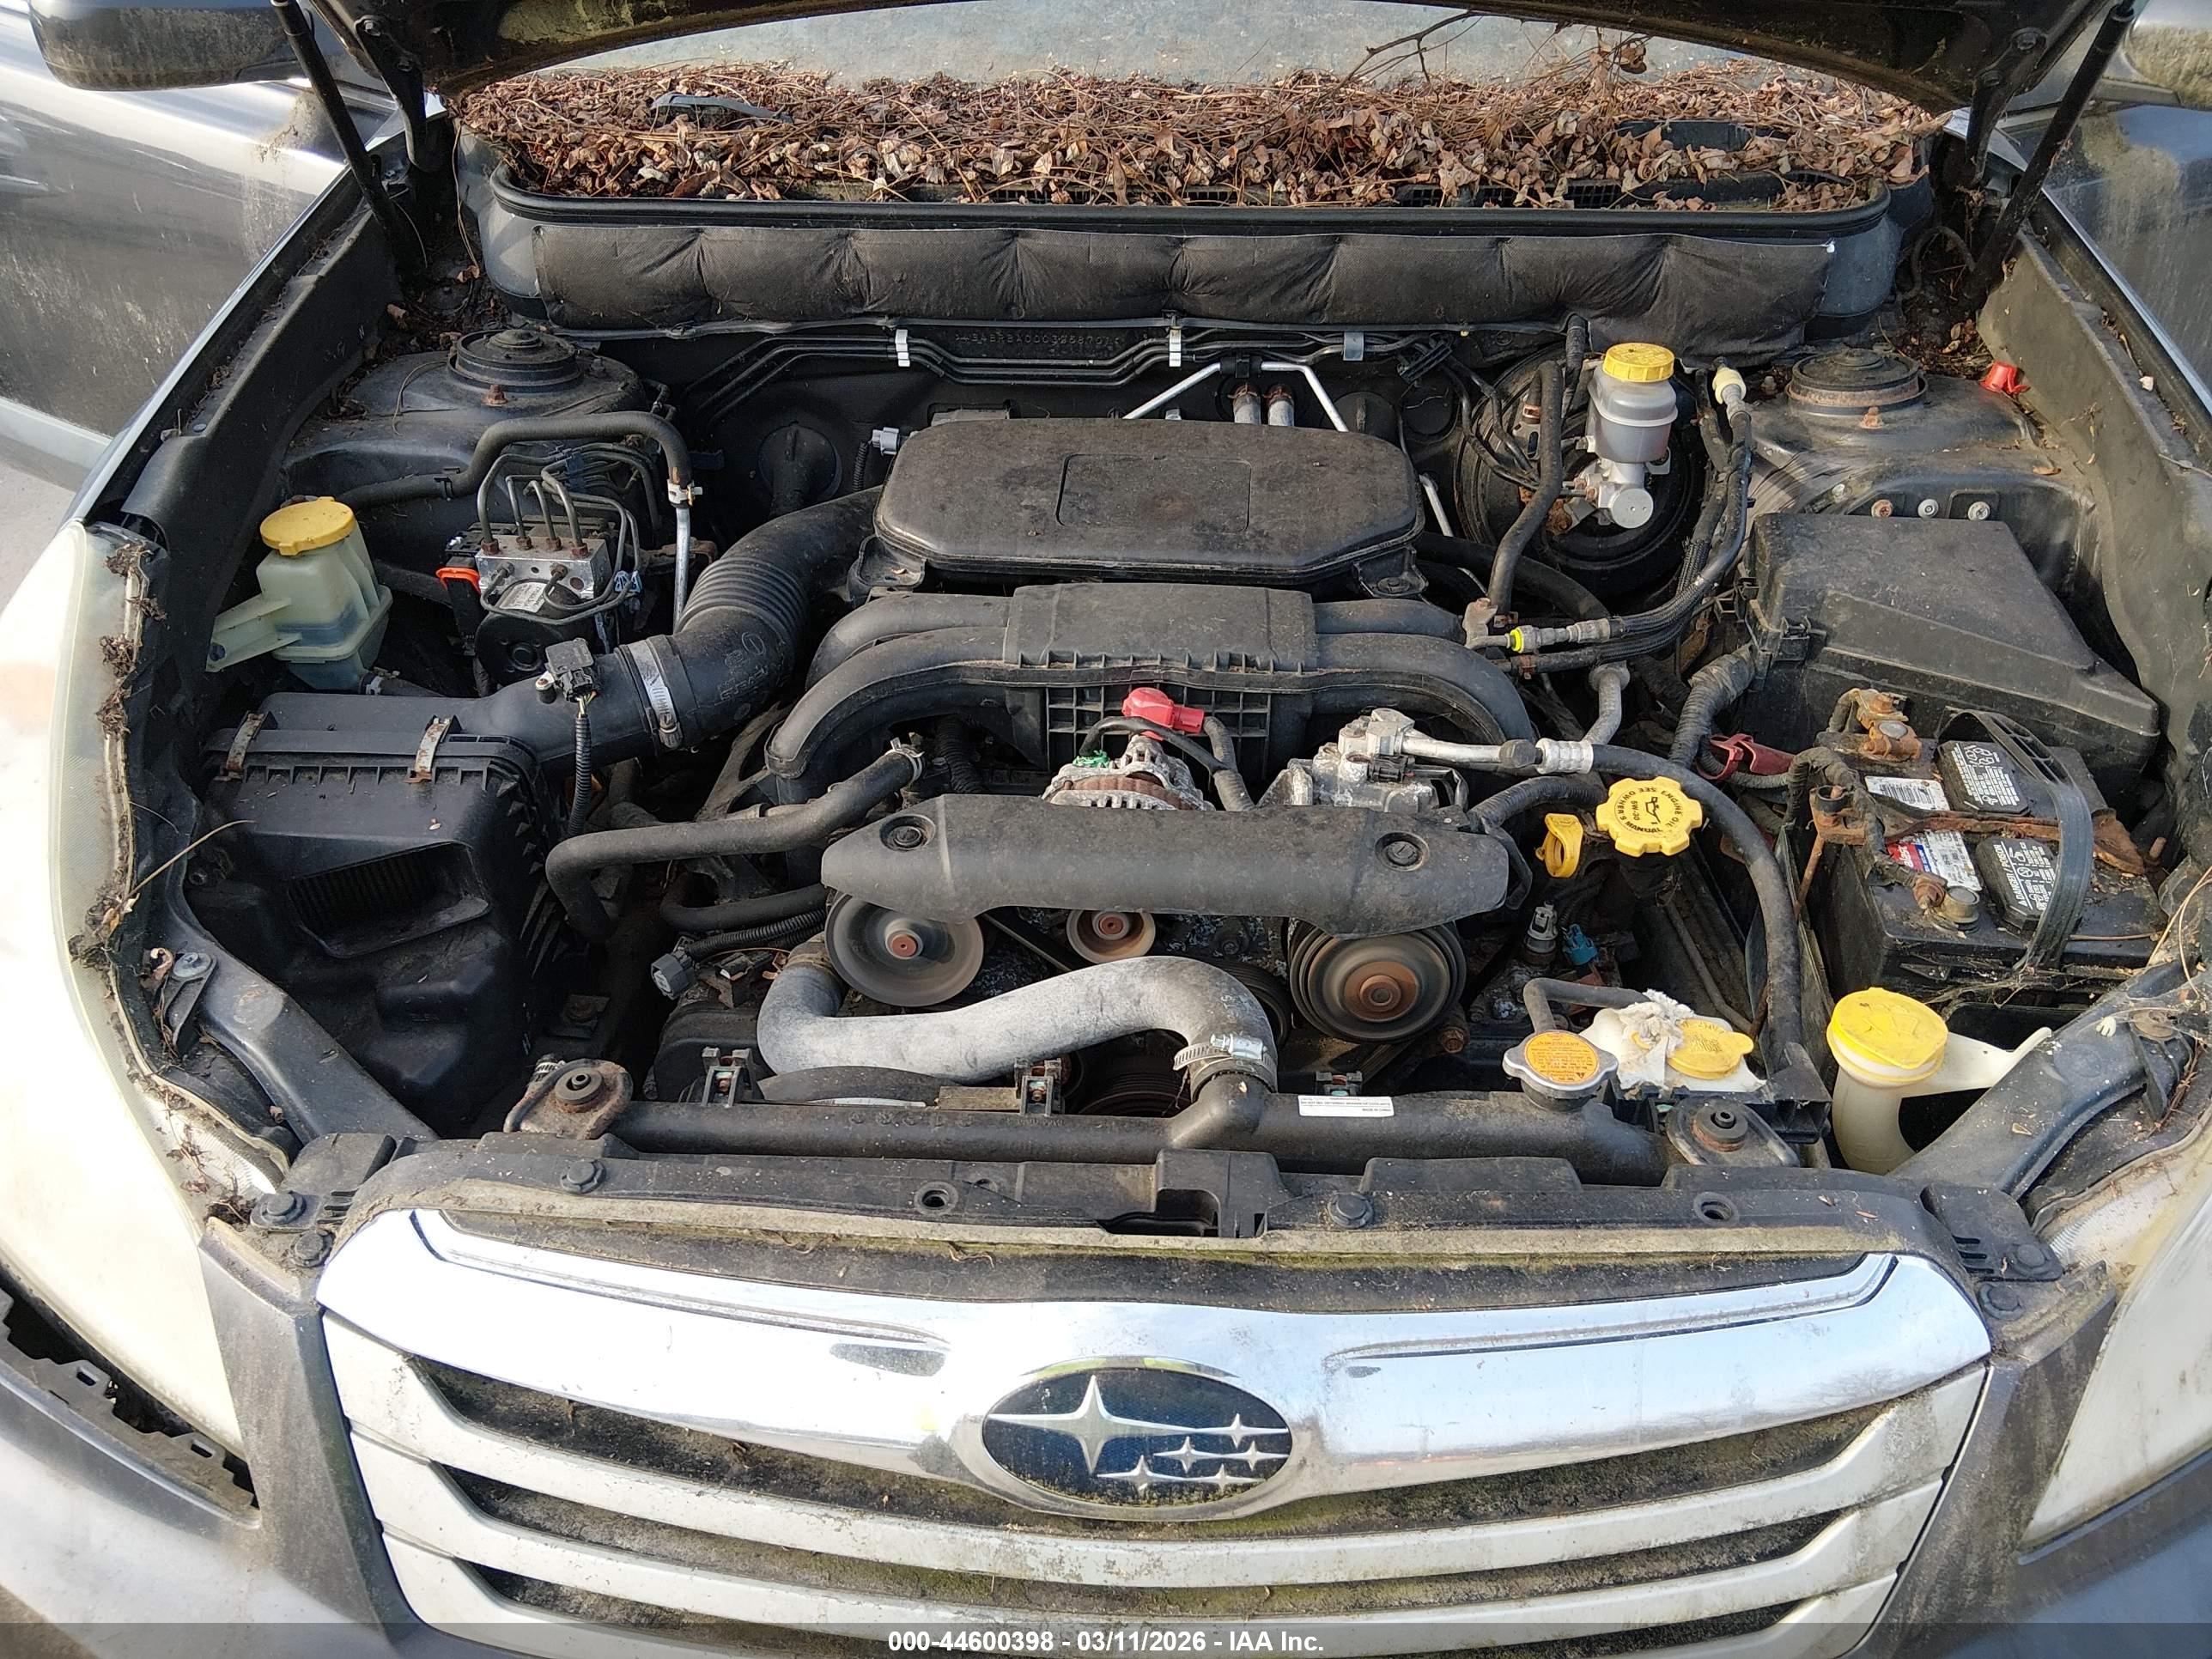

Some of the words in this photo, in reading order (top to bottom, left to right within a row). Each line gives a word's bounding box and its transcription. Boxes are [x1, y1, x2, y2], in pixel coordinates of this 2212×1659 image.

[1631, 800, 1640, 821] 5W-30
[1661, 790, 1683, 815] ENGINE
[1625, 821, 1663, 834] MANUAL
[1665, 817, 1680, 827] OIL
[1992, 844, 2011, 867] POISON
